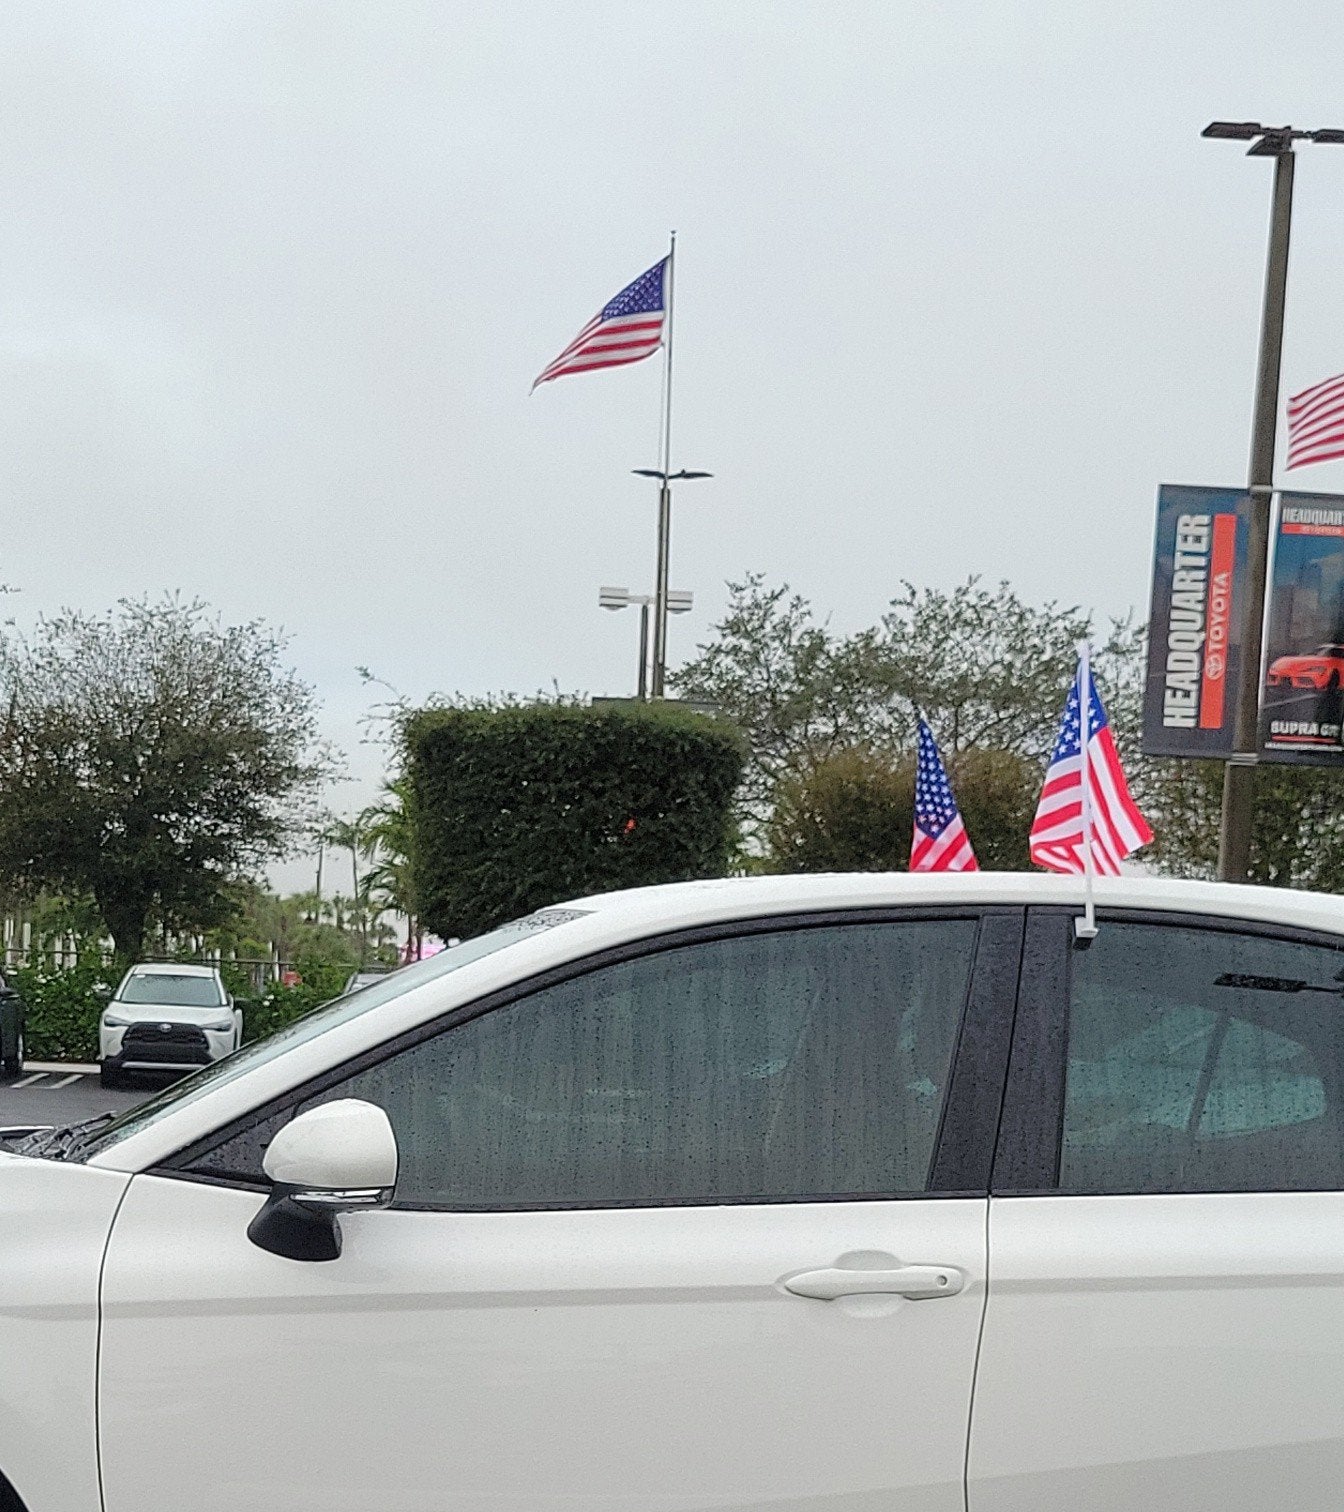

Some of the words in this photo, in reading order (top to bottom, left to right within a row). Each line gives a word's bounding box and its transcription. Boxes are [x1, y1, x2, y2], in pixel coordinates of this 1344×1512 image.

[1163, 513, 1211, 728] HEADQUARTER
[1209, 572, 1232, 654] TOYOTA
[1270, 720, 1319, 735] SUPRA
